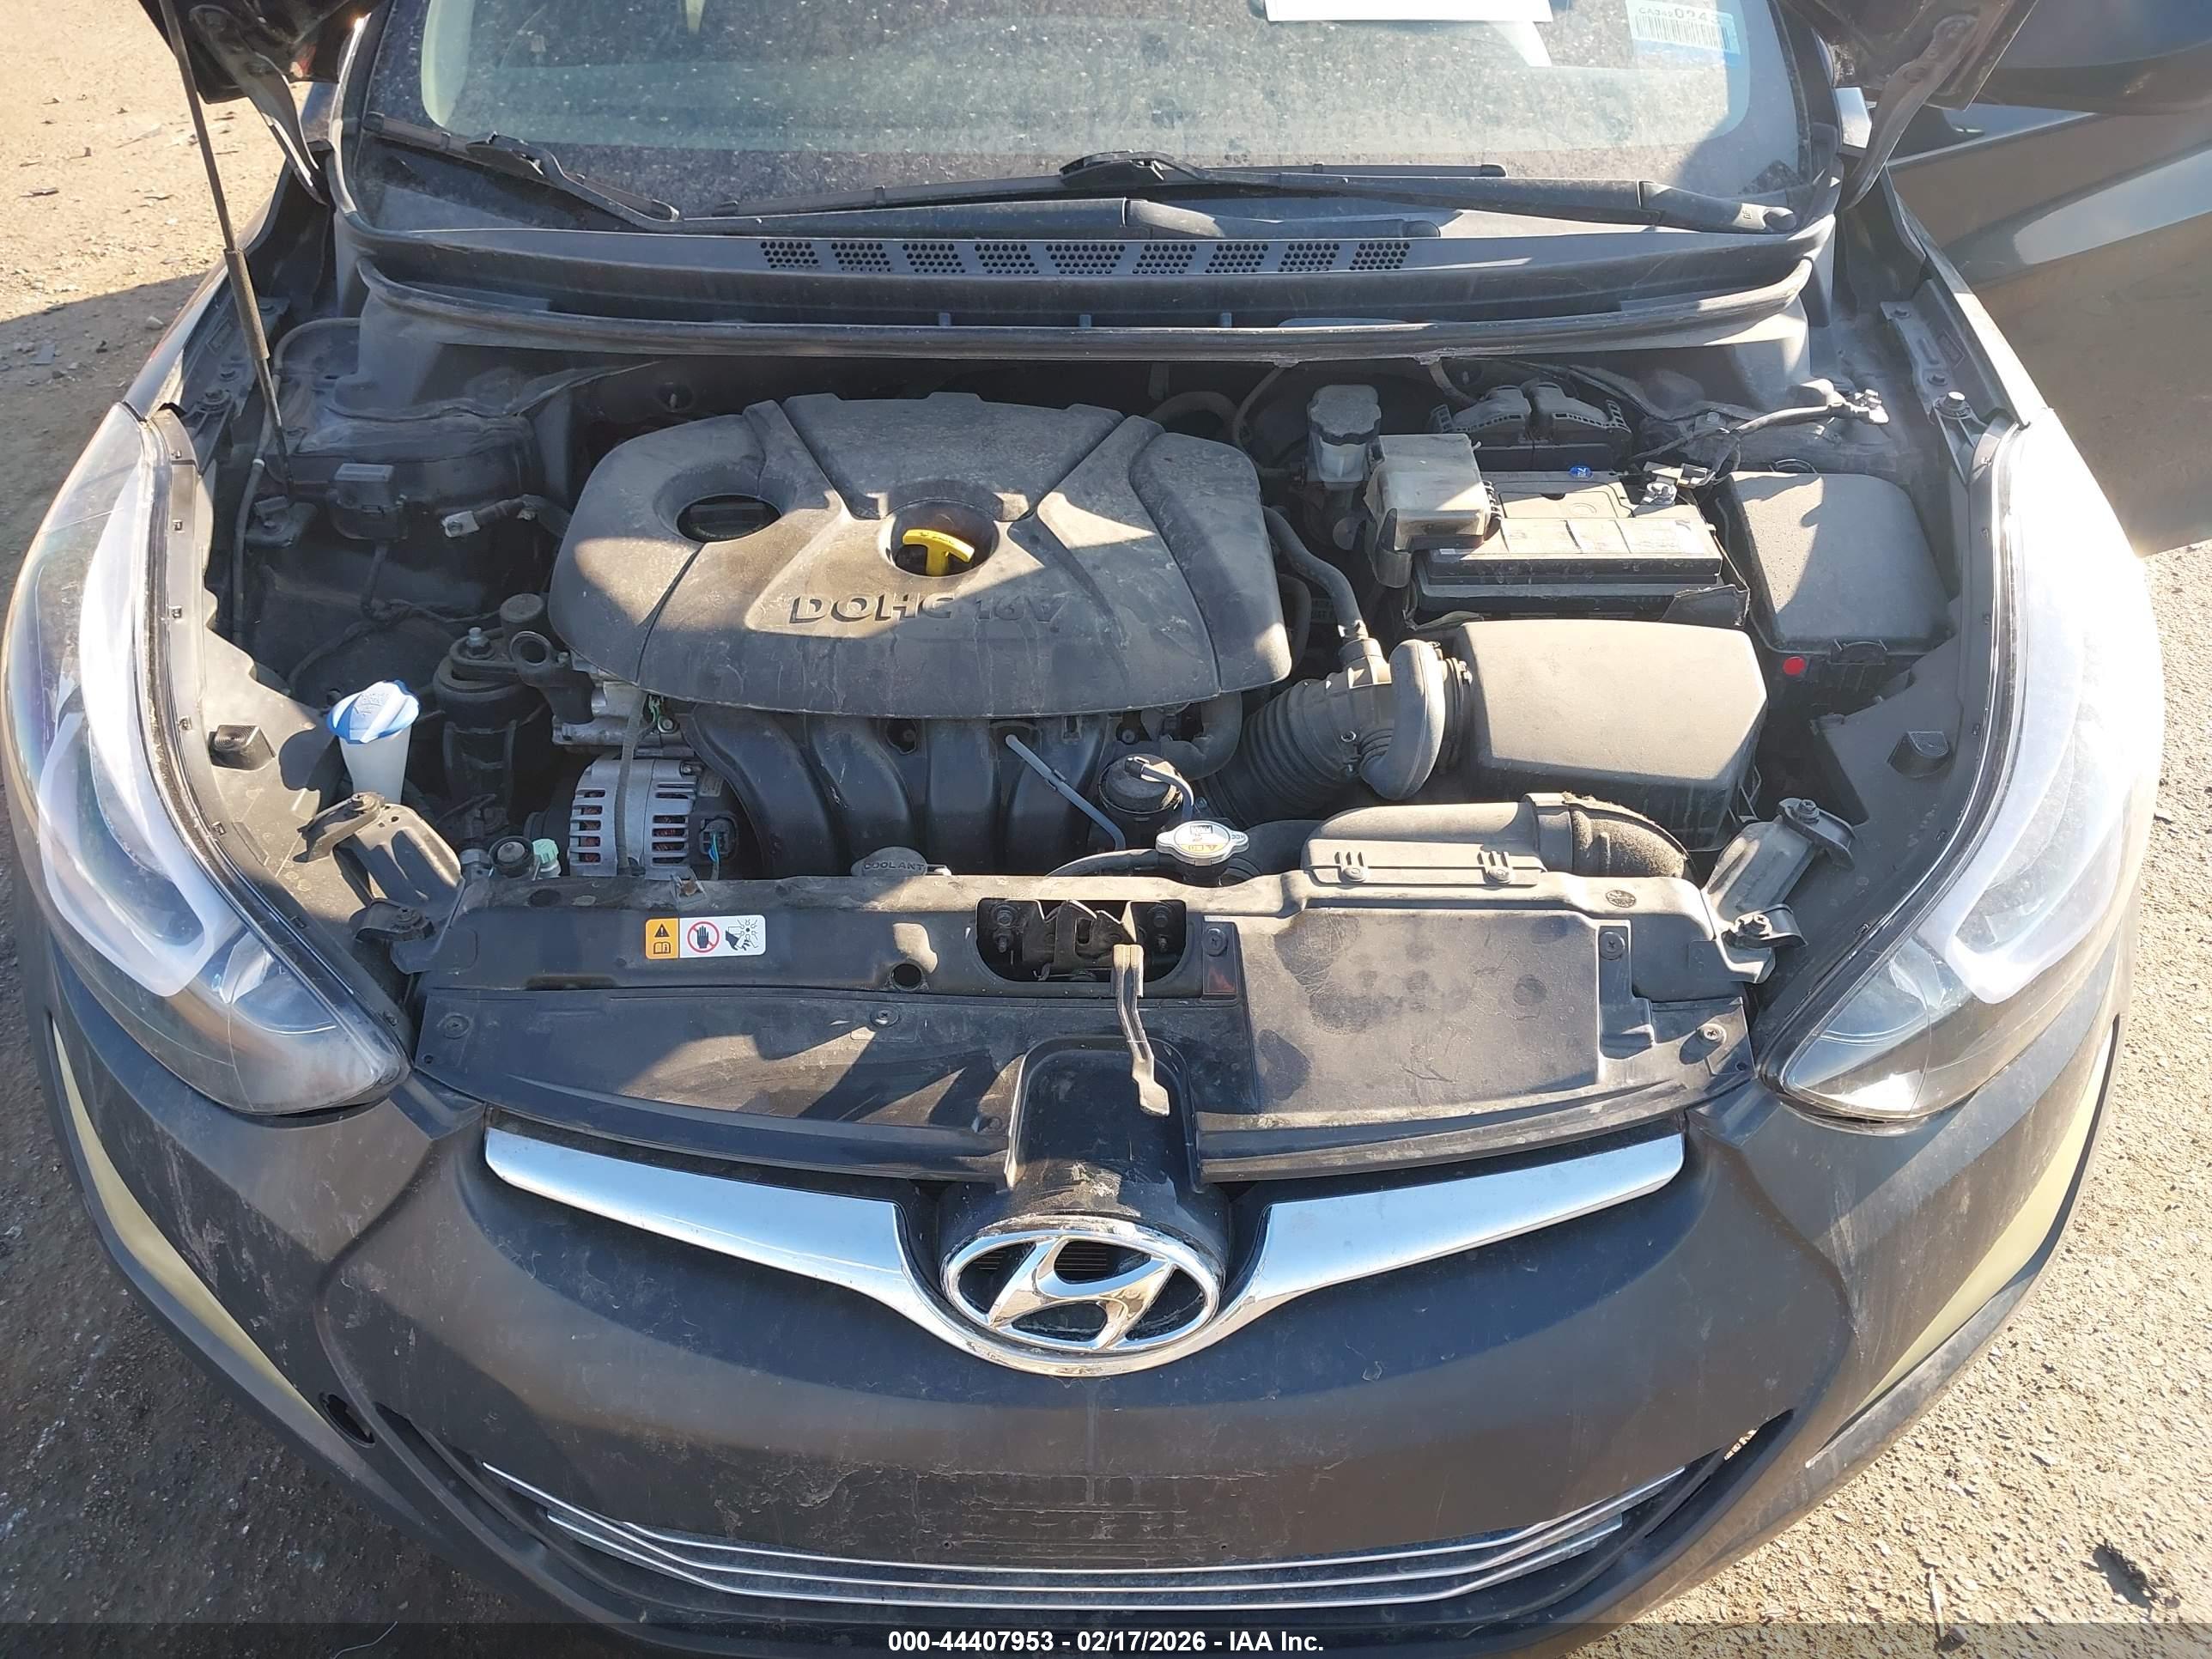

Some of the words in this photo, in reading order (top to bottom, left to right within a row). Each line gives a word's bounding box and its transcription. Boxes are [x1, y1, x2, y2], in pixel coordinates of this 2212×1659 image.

[789, 592, 955, 624] DOHC
[974, 593, 1072, 624] 16V
[864, 861, 925, 871] COOLANT
